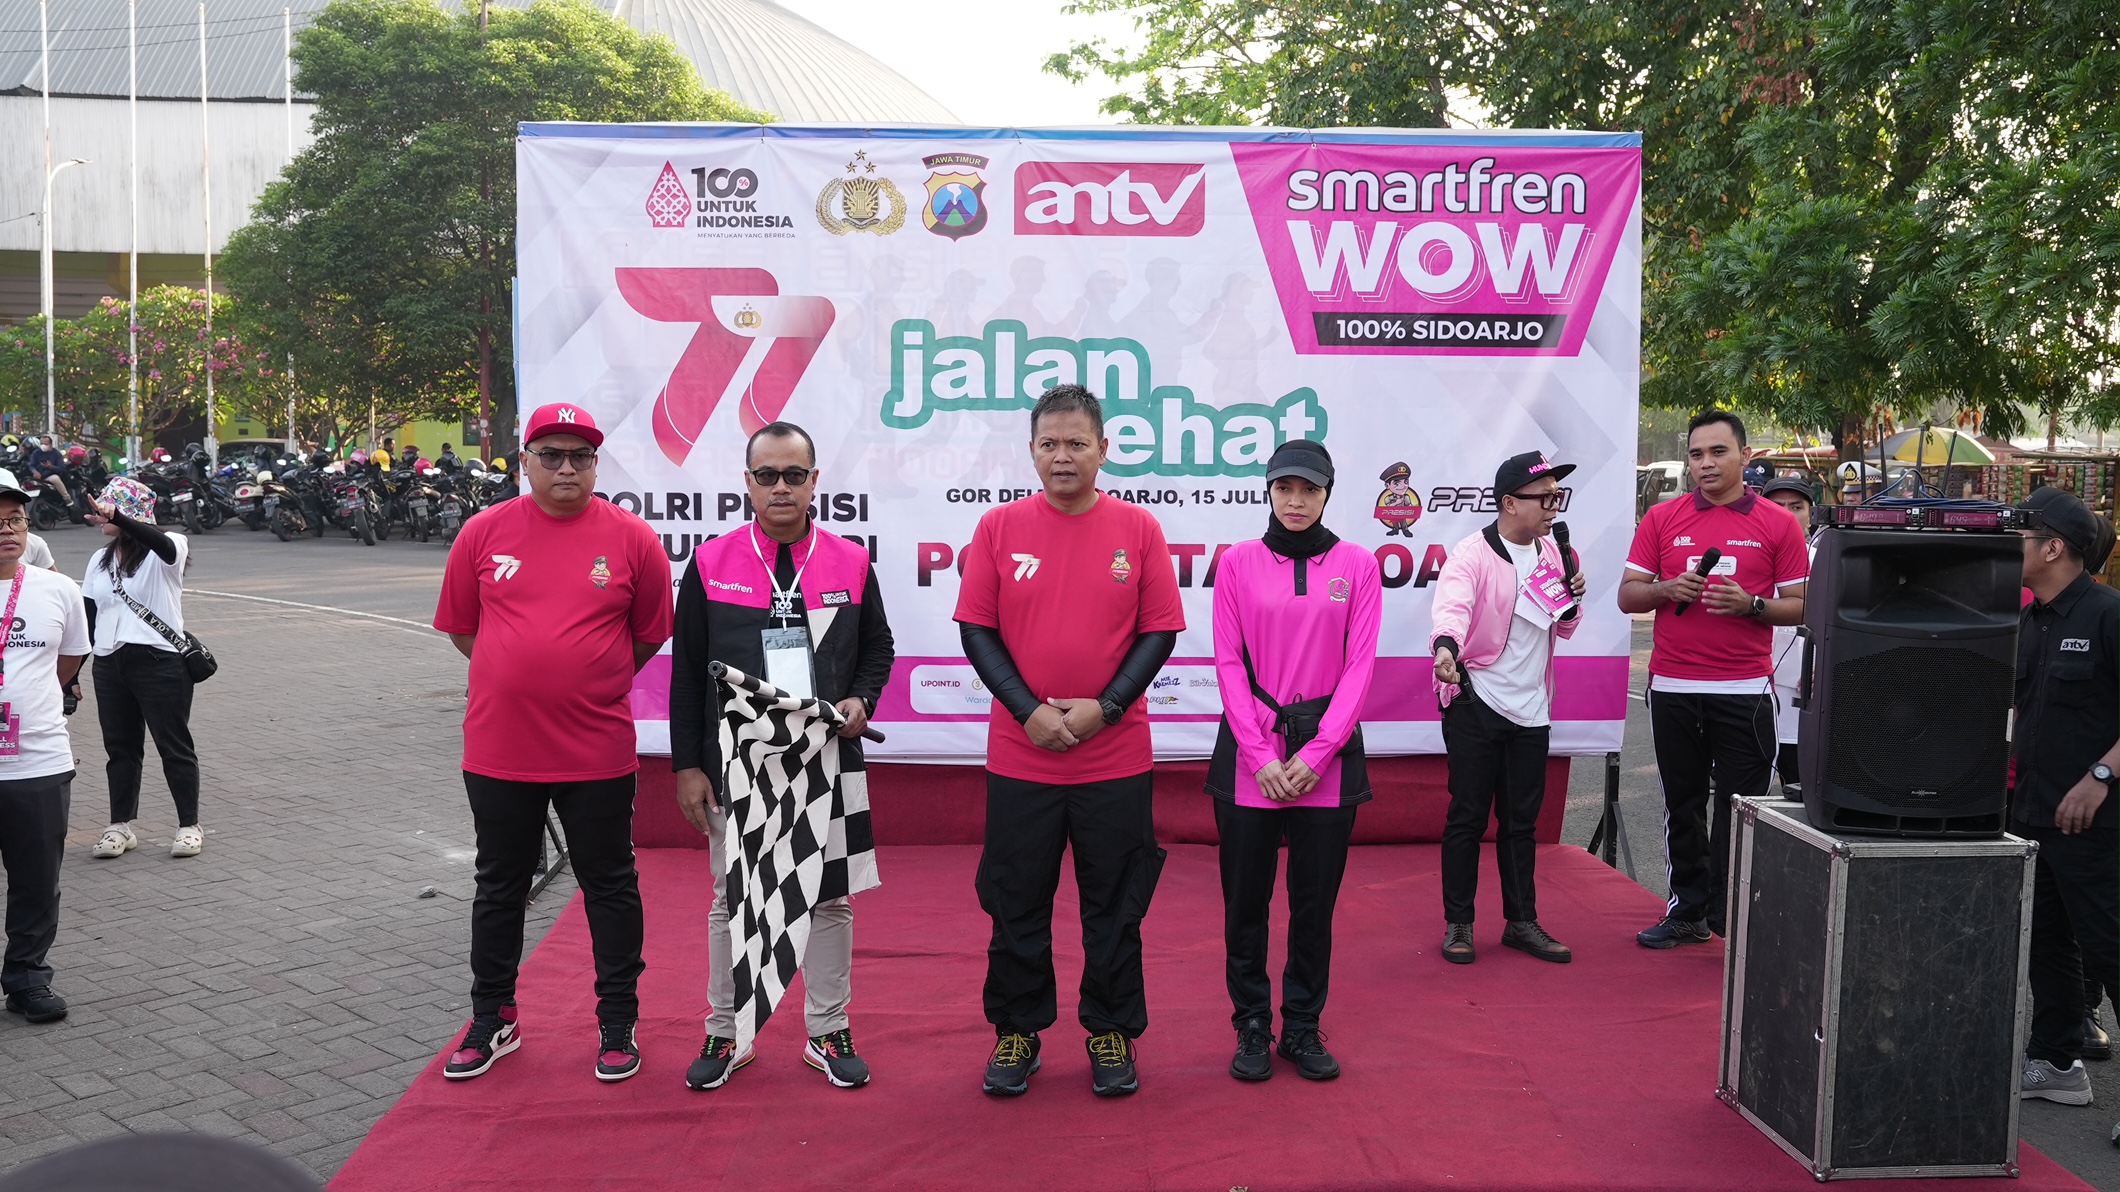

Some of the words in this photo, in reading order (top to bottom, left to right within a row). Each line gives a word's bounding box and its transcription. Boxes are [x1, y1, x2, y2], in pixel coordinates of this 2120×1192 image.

[930, 156, 954, 166] JAWA
[954, 156, 981, 166] TIMUR
[1286, 157, 1587, 214] smartfren
[1024, 165, 1206, 226] antv
[697, 200, 757, 213] UNTUK
[697, 215, 794, 228] INDONESIA
[1286, 219, 1592, 300] WOW
[1336, 319, 1407, 340] 100%
[1411, 319, 1545, 341] SIDOARJO
[889, 328, 1142, 421] jalan
[1105, 394, 1319, 469] ehat
[946, 488, 992, 503] GOR
[1191, 489, 1215, 504] 15
[1221, 489, 1269, 505] JULI
[1726, 539, 1762, 548] smartfren
[707, 578, 753, 594] smartfren
